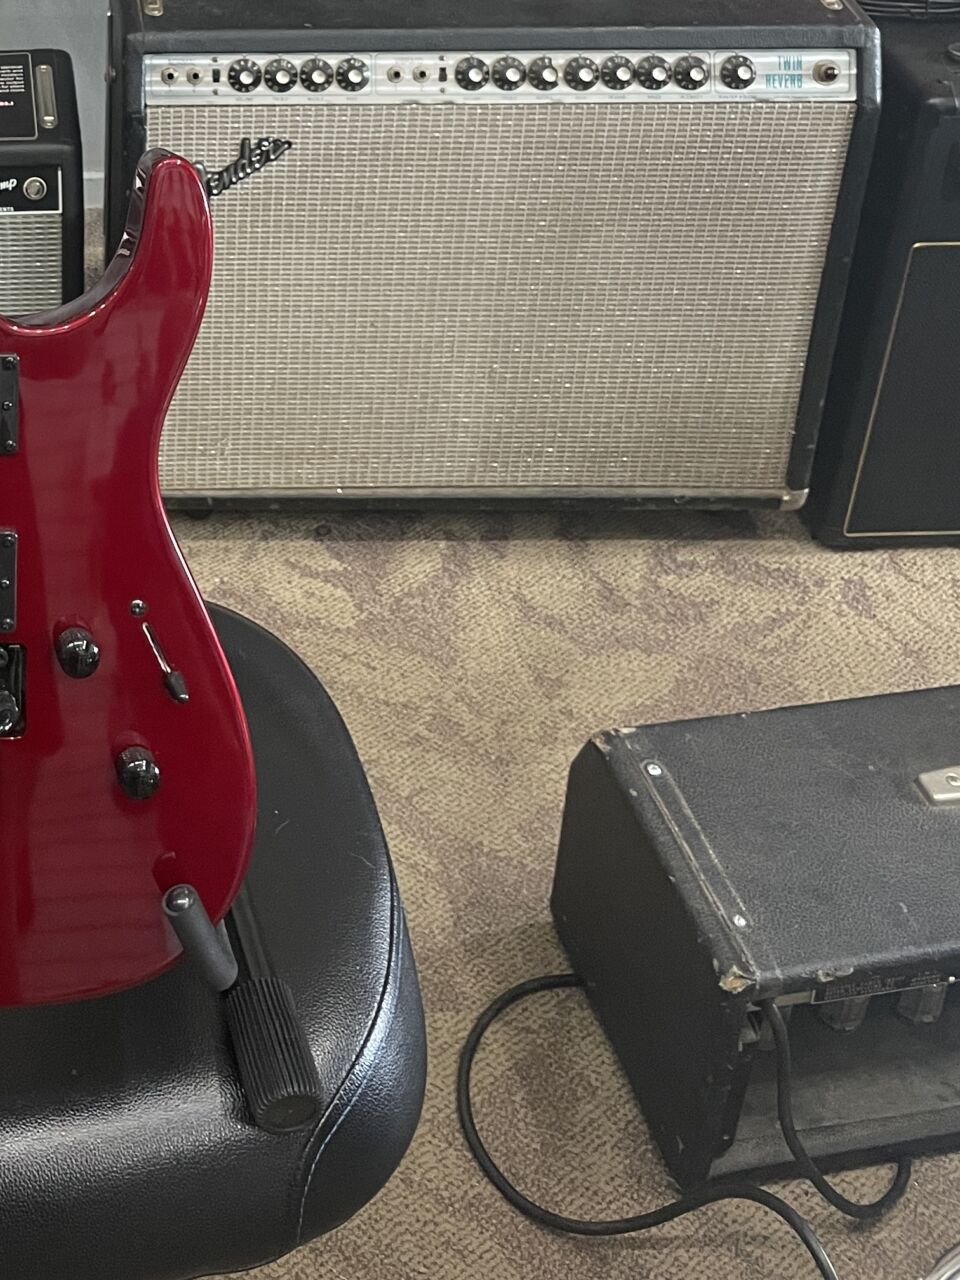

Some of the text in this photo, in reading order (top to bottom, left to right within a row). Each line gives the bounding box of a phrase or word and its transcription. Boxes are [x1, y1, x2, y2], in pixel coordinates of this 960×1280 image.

[778, 56, 803, 70] TWIN
[765, 74, 803, 89] REVERB
[206, 137, 292, 196] ender
